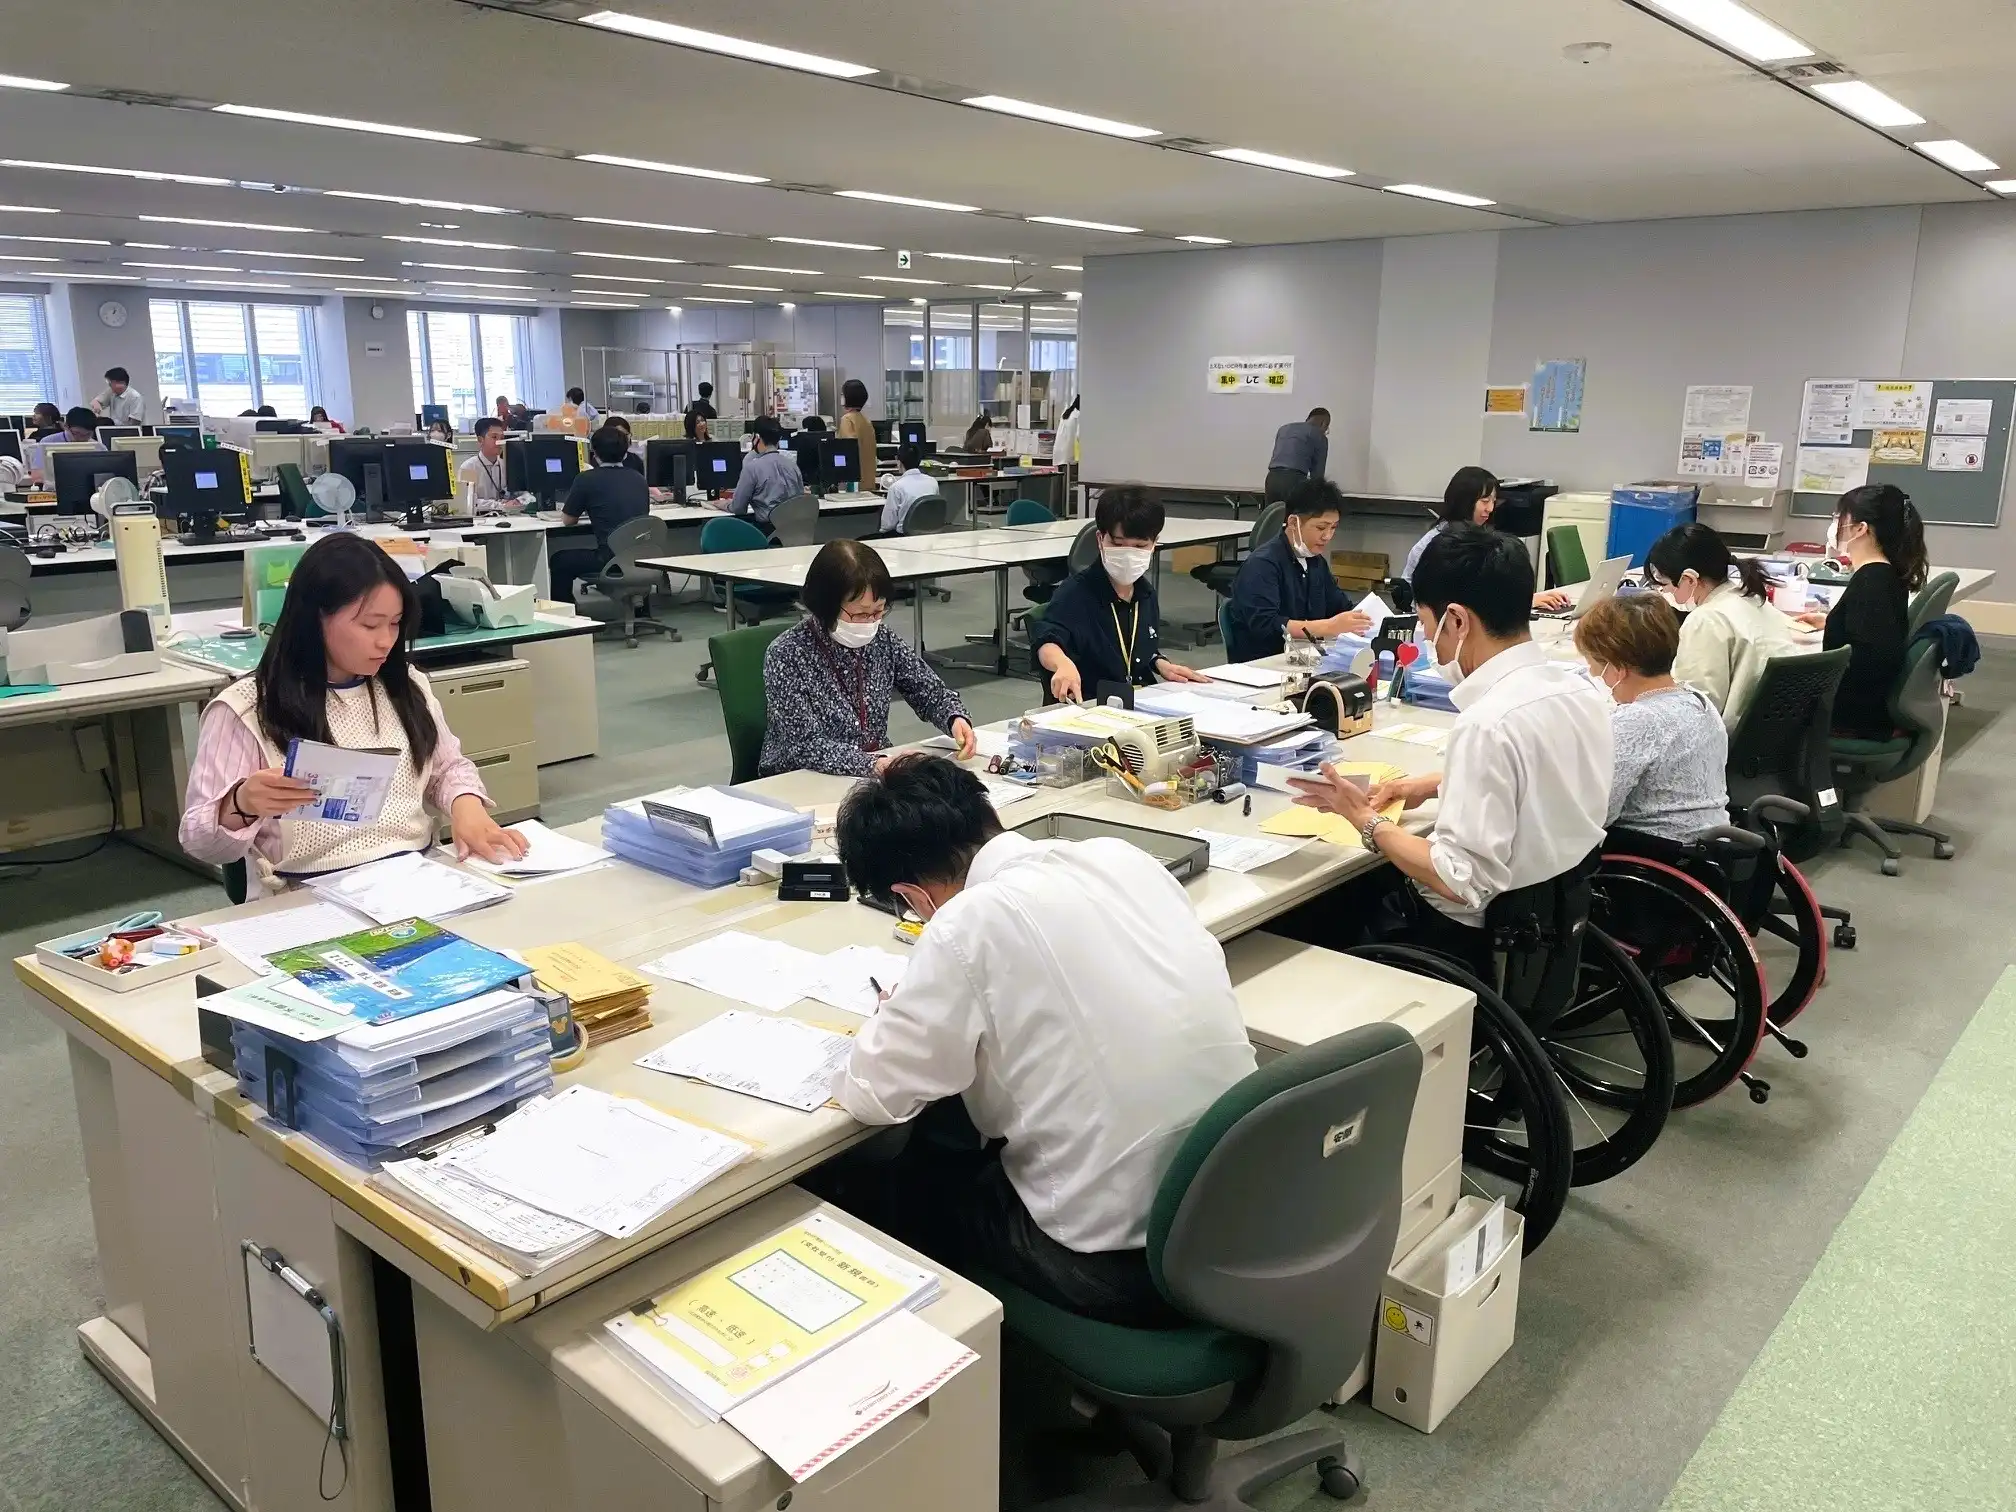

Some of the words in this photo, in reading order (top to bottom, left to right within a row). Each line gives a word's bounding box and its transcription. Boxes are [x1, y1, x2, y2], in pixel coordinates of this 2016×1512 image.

[1221, 376, 1235, 384] 集中
[1246, 376, 1259, 384] して
[1269, 375, 1284, 384] 確認
